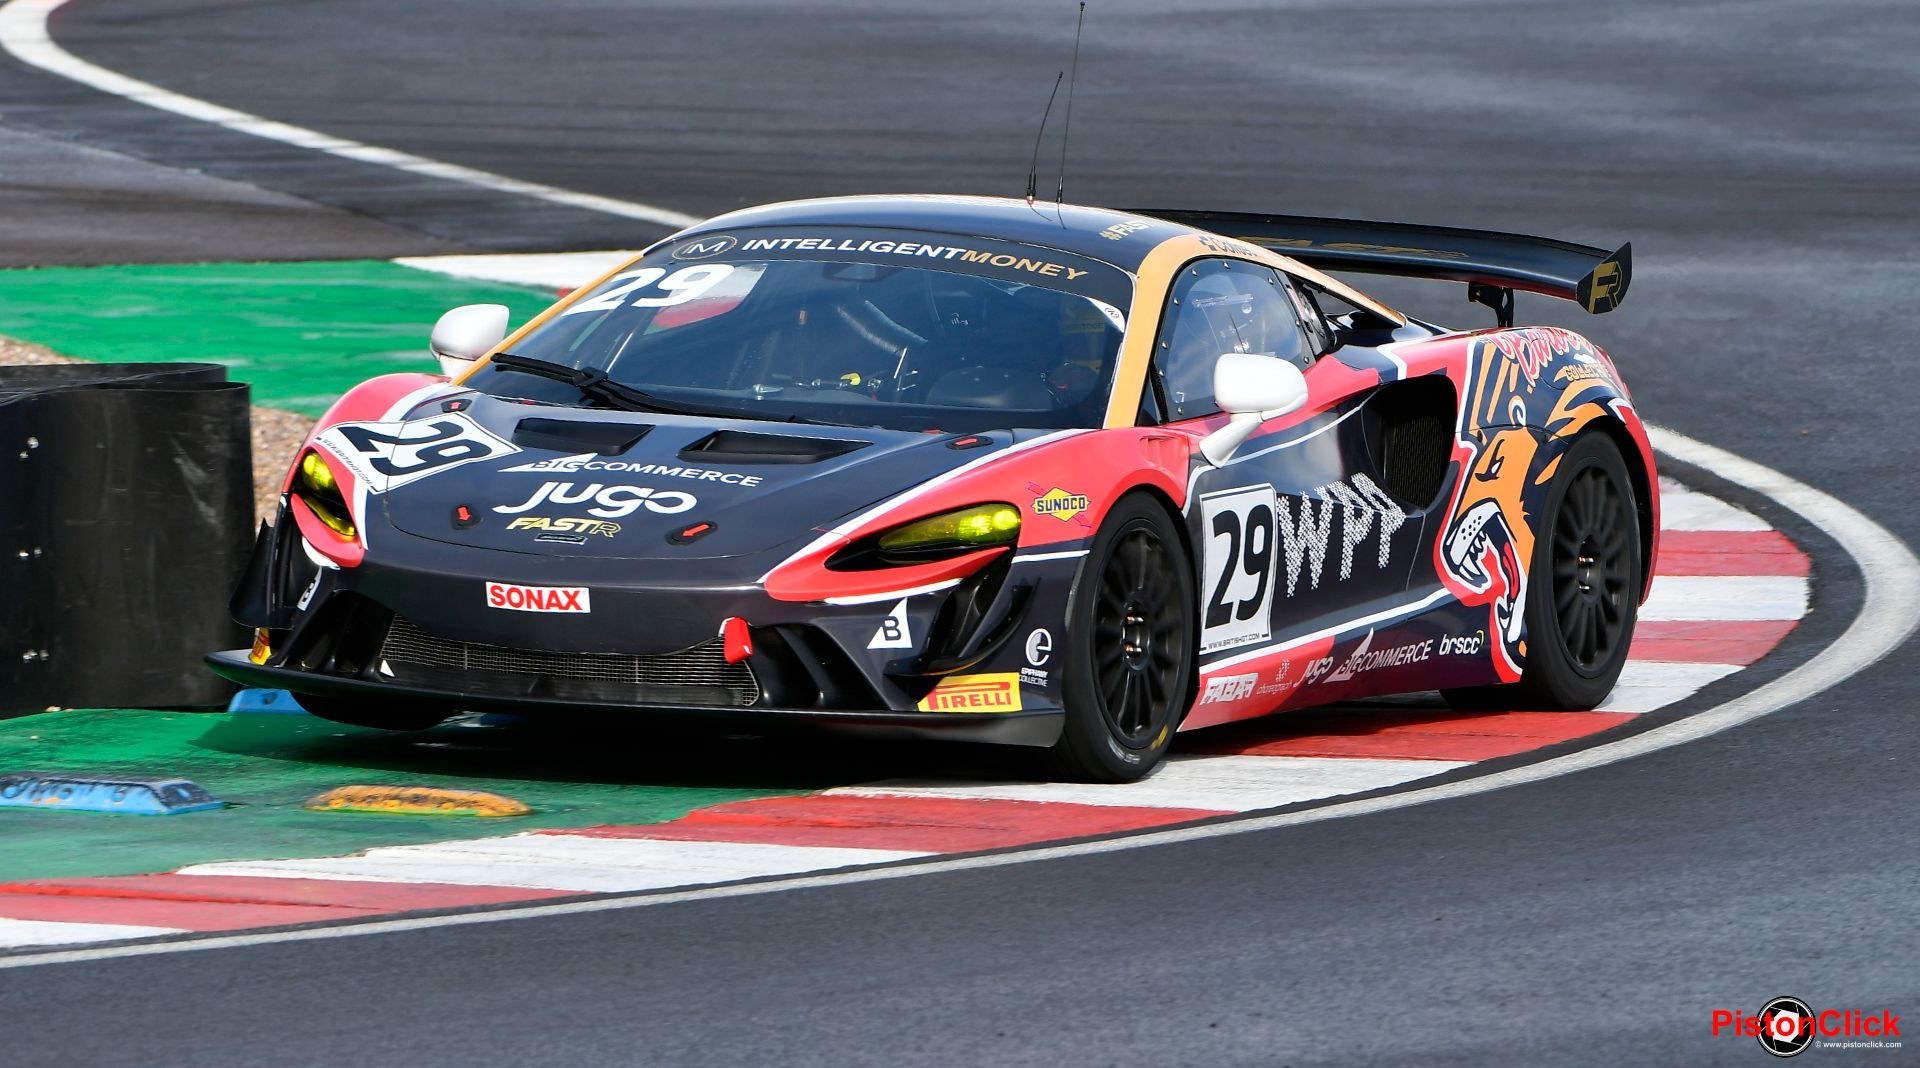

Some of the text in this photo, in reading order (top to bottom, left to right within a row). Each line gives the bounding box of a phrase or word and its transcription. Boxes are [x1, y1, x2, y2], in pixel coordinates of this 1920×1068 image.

[560, 263, 736, 317] 29
[337, 420, 493, 477] 29
[1036, 497, 1086, 513] SUNOCO
[506, 517, 622, 538] FASTR
[1276, 472, 1407, 598] WPP
[1204, 503, 1275, 630] 29
[490, 585, 583, 611] SONAX
[1439, 634, 1480, 656] brscc
[926, 682, 1012, 711] PIRELLI
